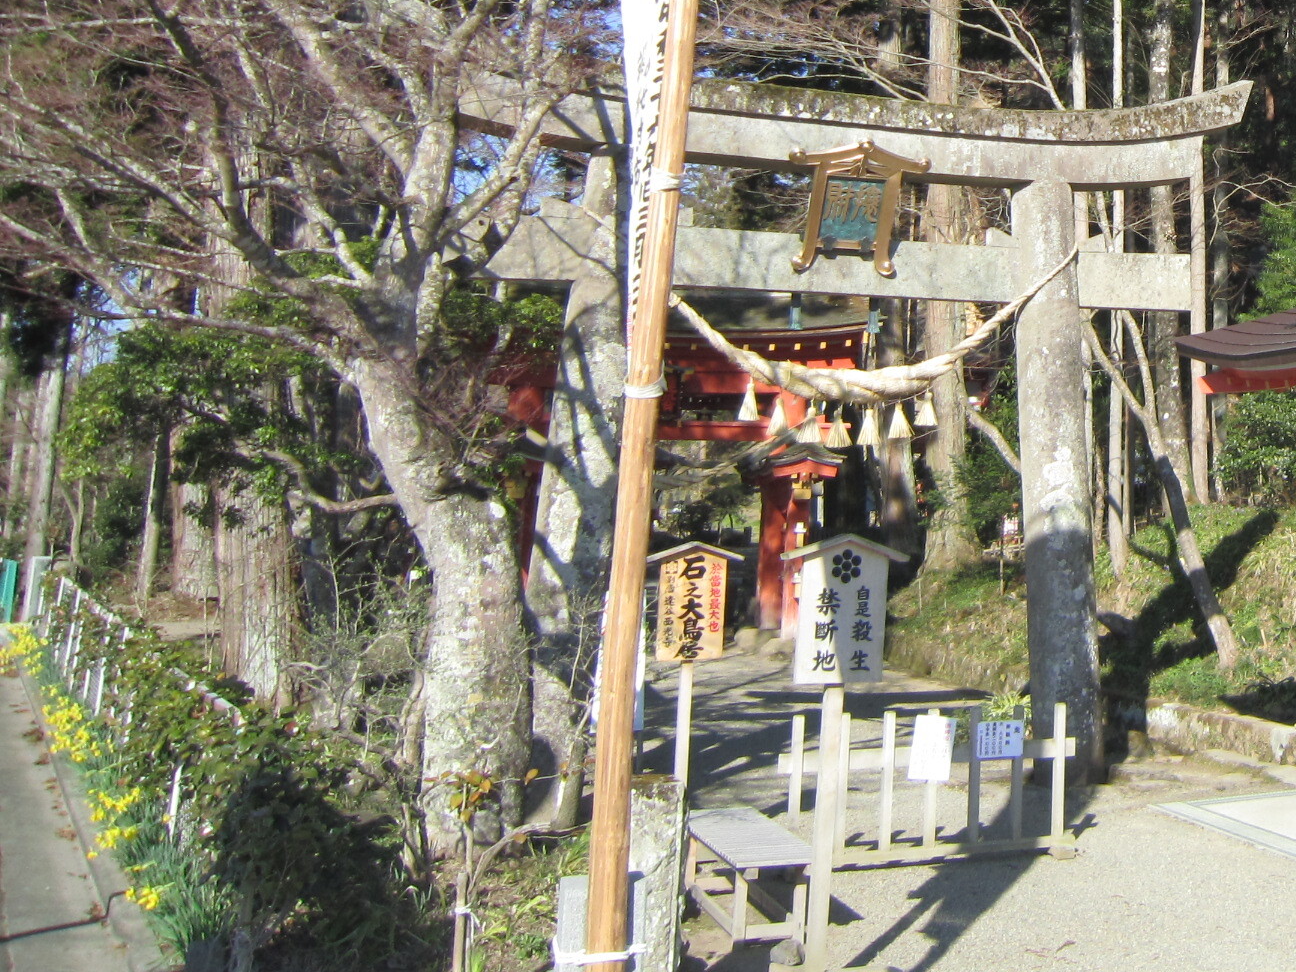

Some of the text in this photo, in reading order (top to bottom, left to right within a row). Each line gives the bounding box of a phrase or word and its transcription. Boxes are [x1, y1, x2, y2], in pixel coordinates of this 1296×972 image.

[674, 555, 707, 660] 石之大鳥居
[850, 585, 873, 672] 自是殺生
